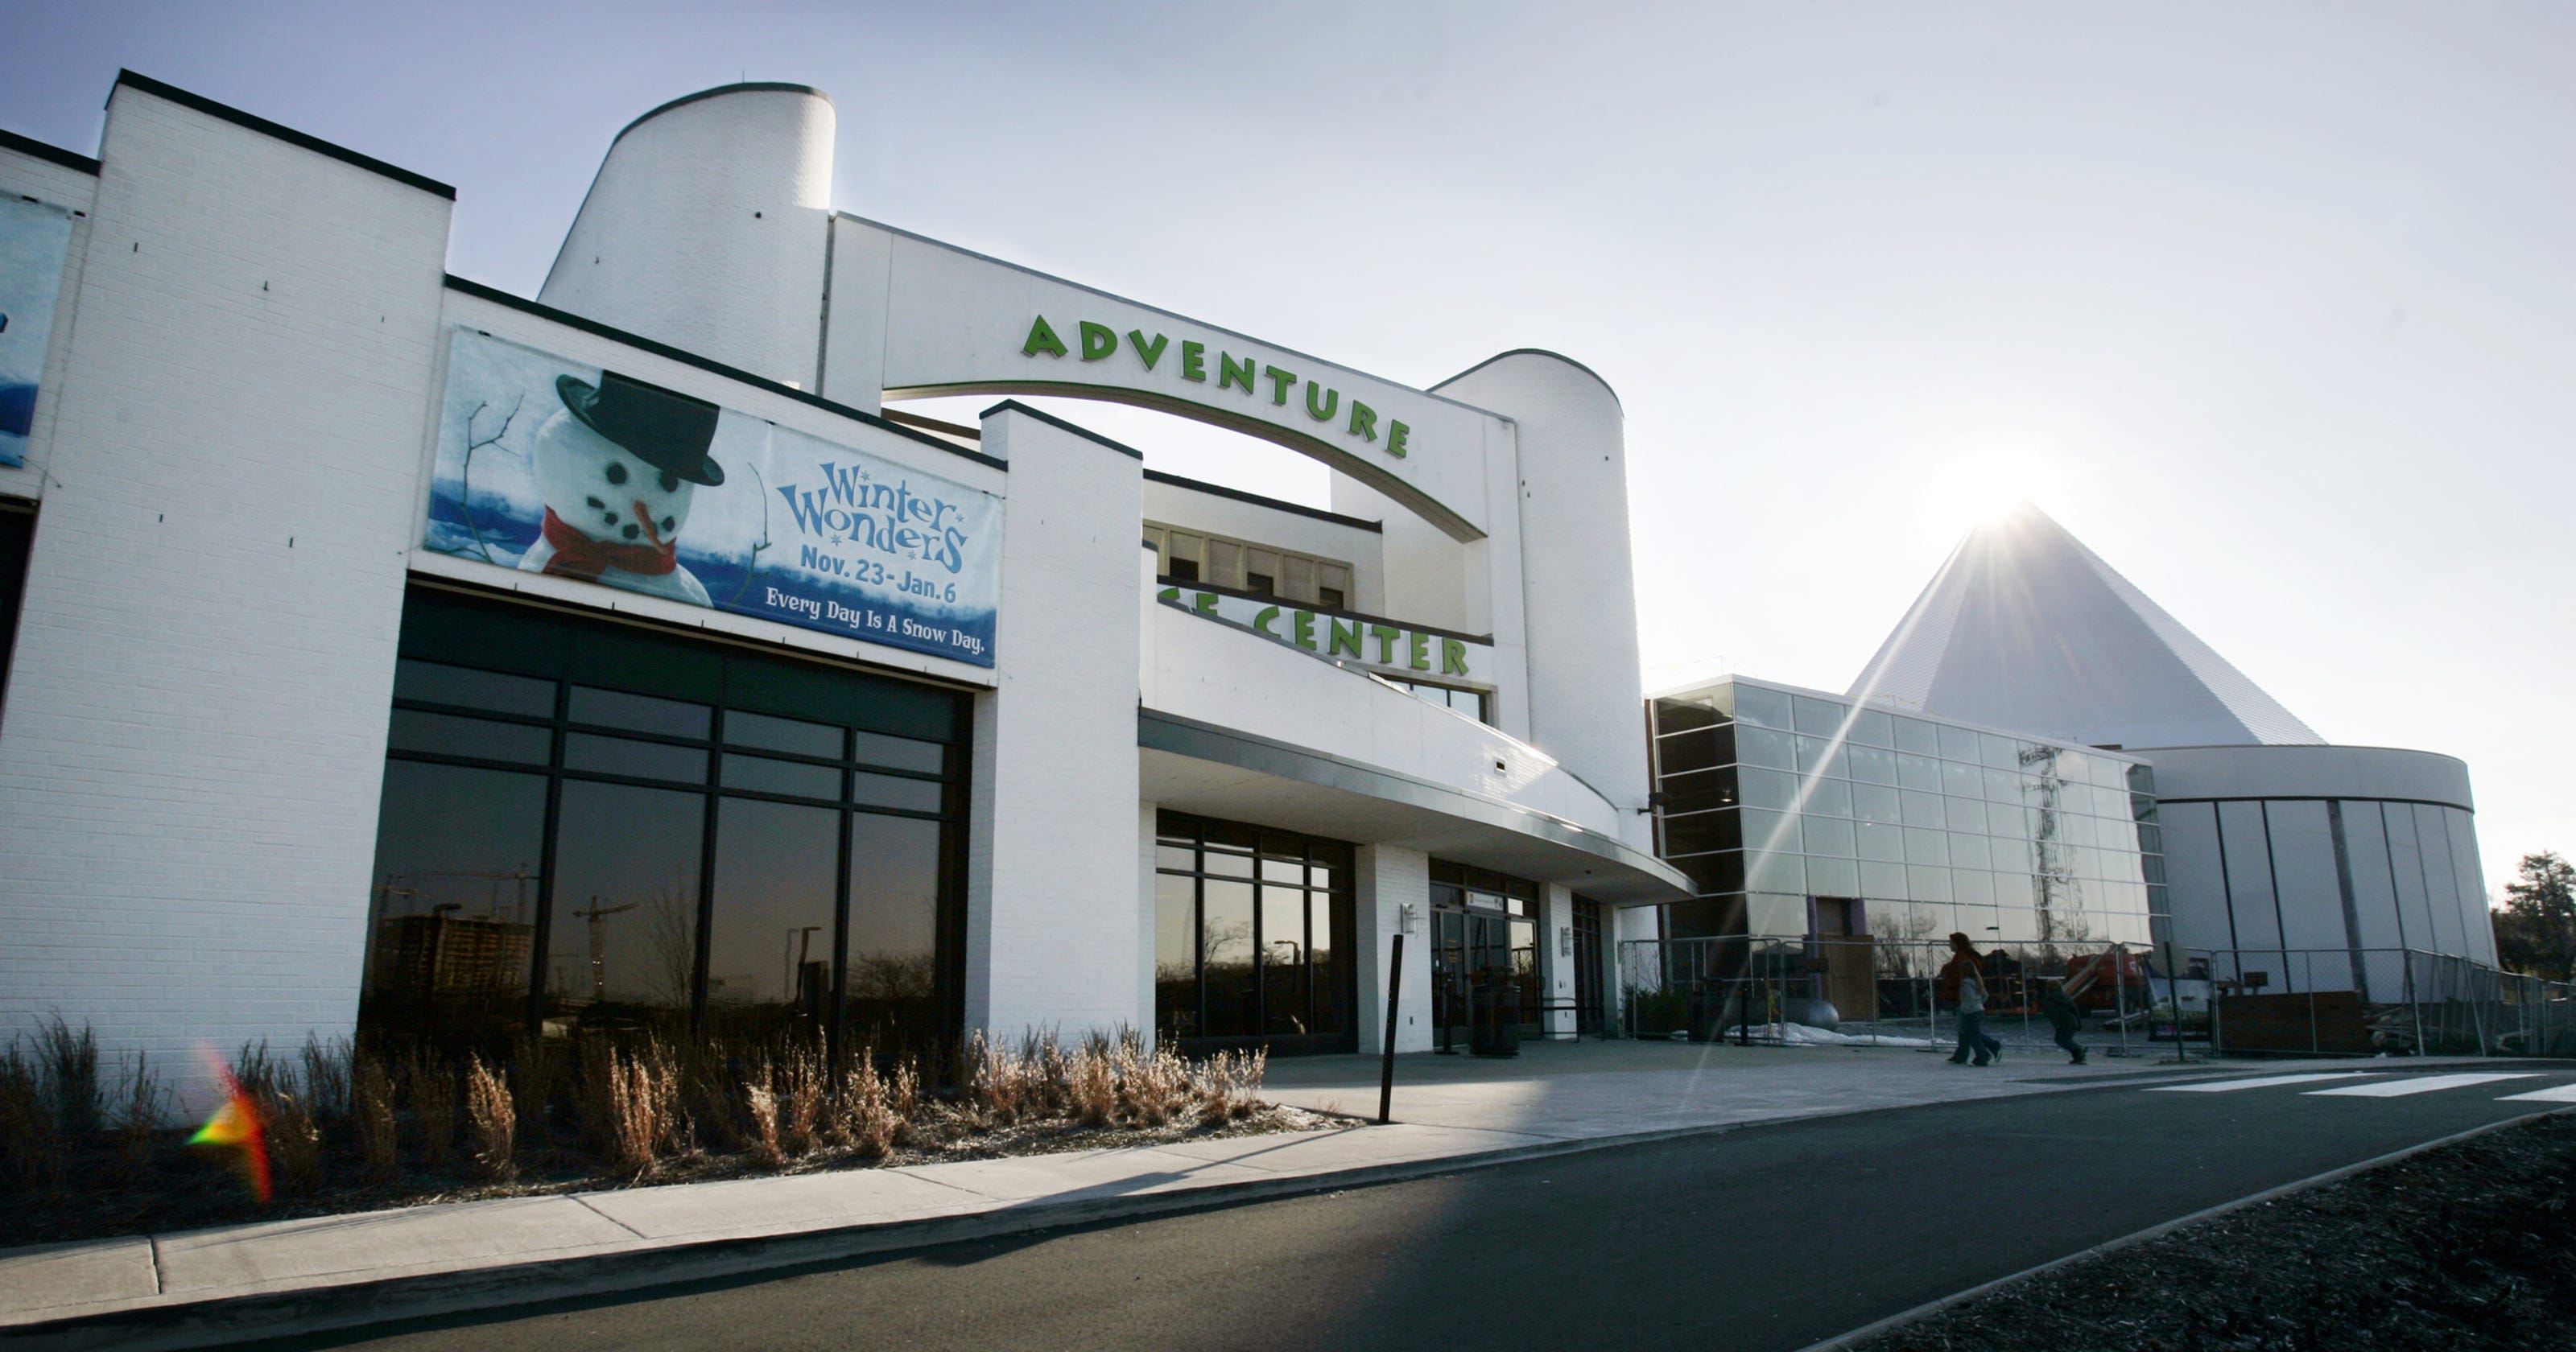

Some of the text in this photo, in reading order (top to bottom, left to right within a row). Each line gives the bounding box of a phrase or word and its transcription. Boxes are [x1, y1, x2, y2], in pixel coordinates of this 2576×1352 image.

[1020, 314, 1410, 459] ADVENTURE
[819, 461, 957, 532] Winter
[800, 544, 850, 578] Nov.
[766, 587, 985, 655] Every Day Is A Snow Day.
[1253, 606, 1469, 676] CENTER
